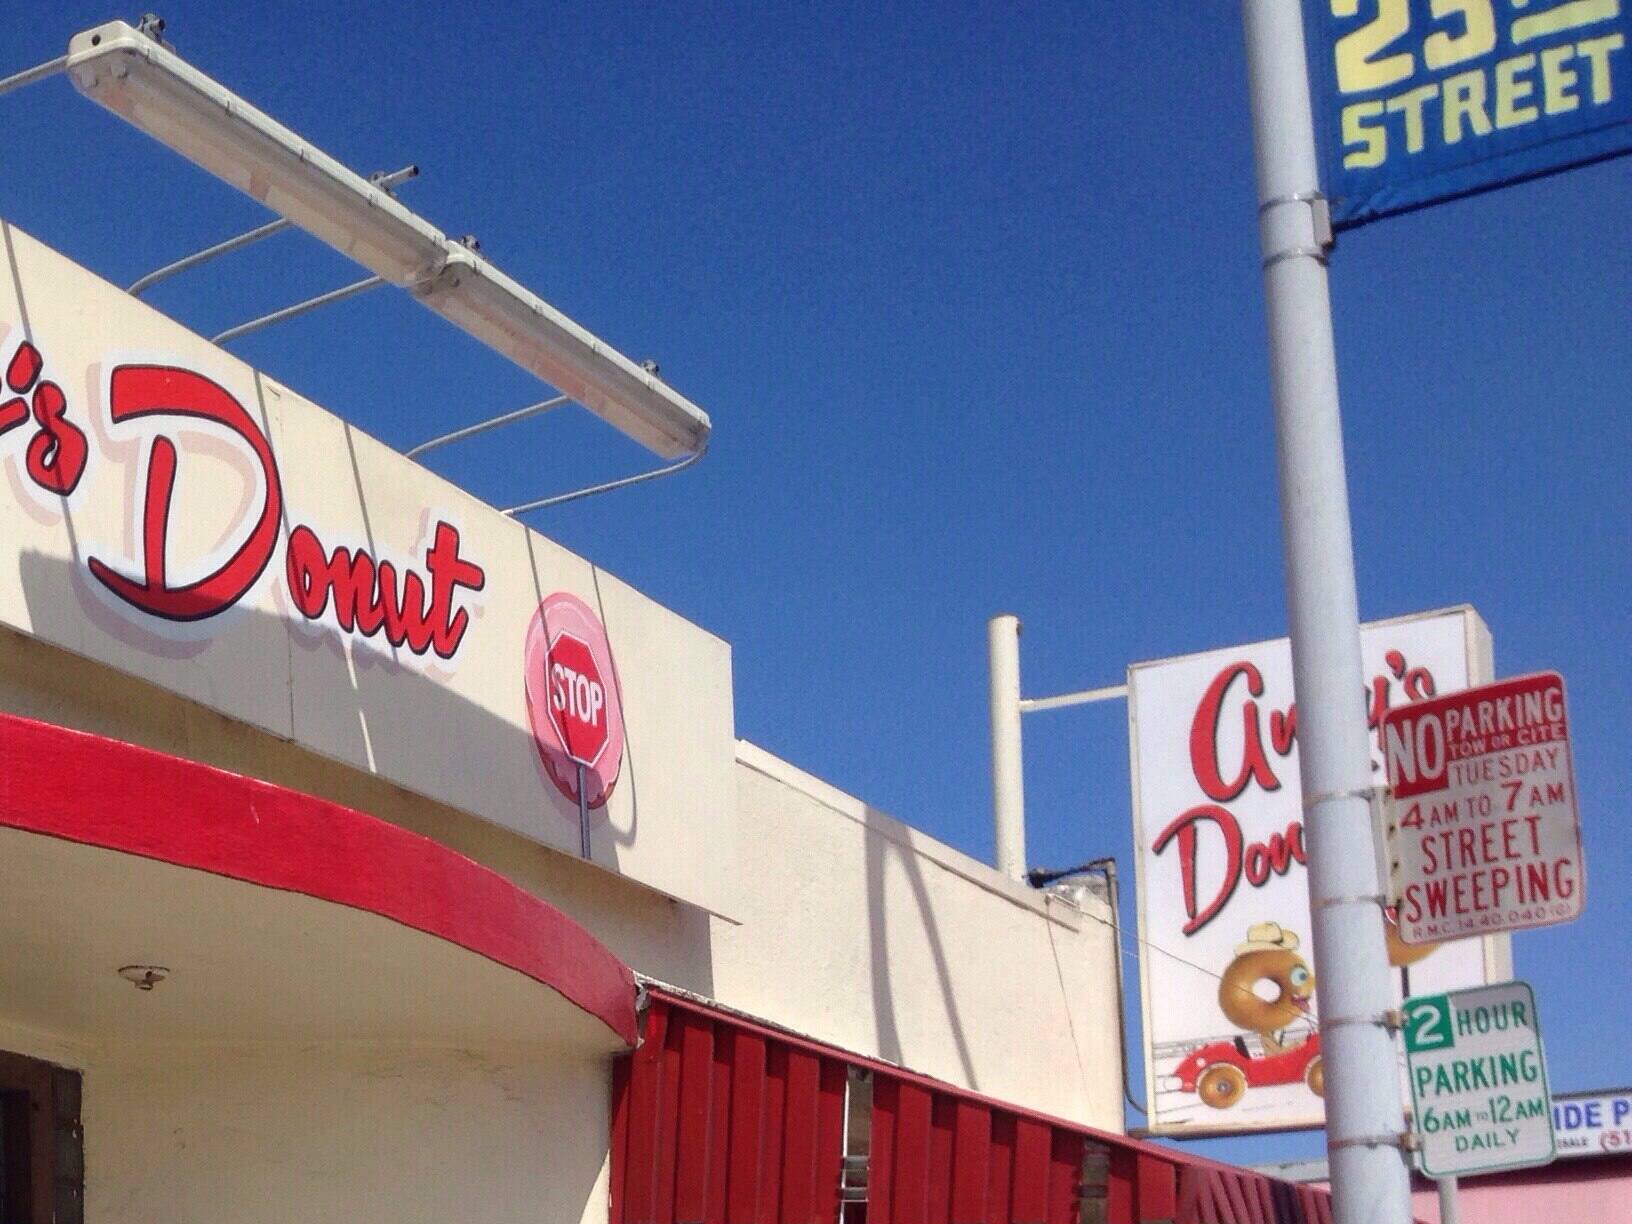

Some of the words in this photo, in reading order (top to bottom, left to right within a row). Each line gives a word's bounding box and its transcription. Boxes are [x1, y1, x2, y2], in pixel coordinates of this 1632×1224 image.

[1341, 33, 1625, 170] STREET
[88, 364, 485, 659] Donut
[551, 663, 603, 727] STOP
[1445, 687, 1563, 740] PARKING
[1386, 714, 1446, 786] NO
[1448, 741, 1485, 759] TOW
[1491, 734, 1510, 747] OR
[1519, 723, 1565, 746] CITE
[1453, 748, 1558, 785] TUESDAY
[1466, 795, 1491, 819] TO
[1421, 816, 1542, 875] STREET
[1405, 858, 1574, 923] SWEEPING
[1409, 1004, 1444, 1046] 2
[1455, 1001, 1528, 1037] HOUR
[1415, 1050, 1539, 1099] PARKING
[1423, 1107, 1472, 1134] 6AM
[1488, 1095, 1545, 1125] 12AM
[1553, 1102, 1602, 1130] IDE
[1455, 1128, 1521, 1152] DAILY
